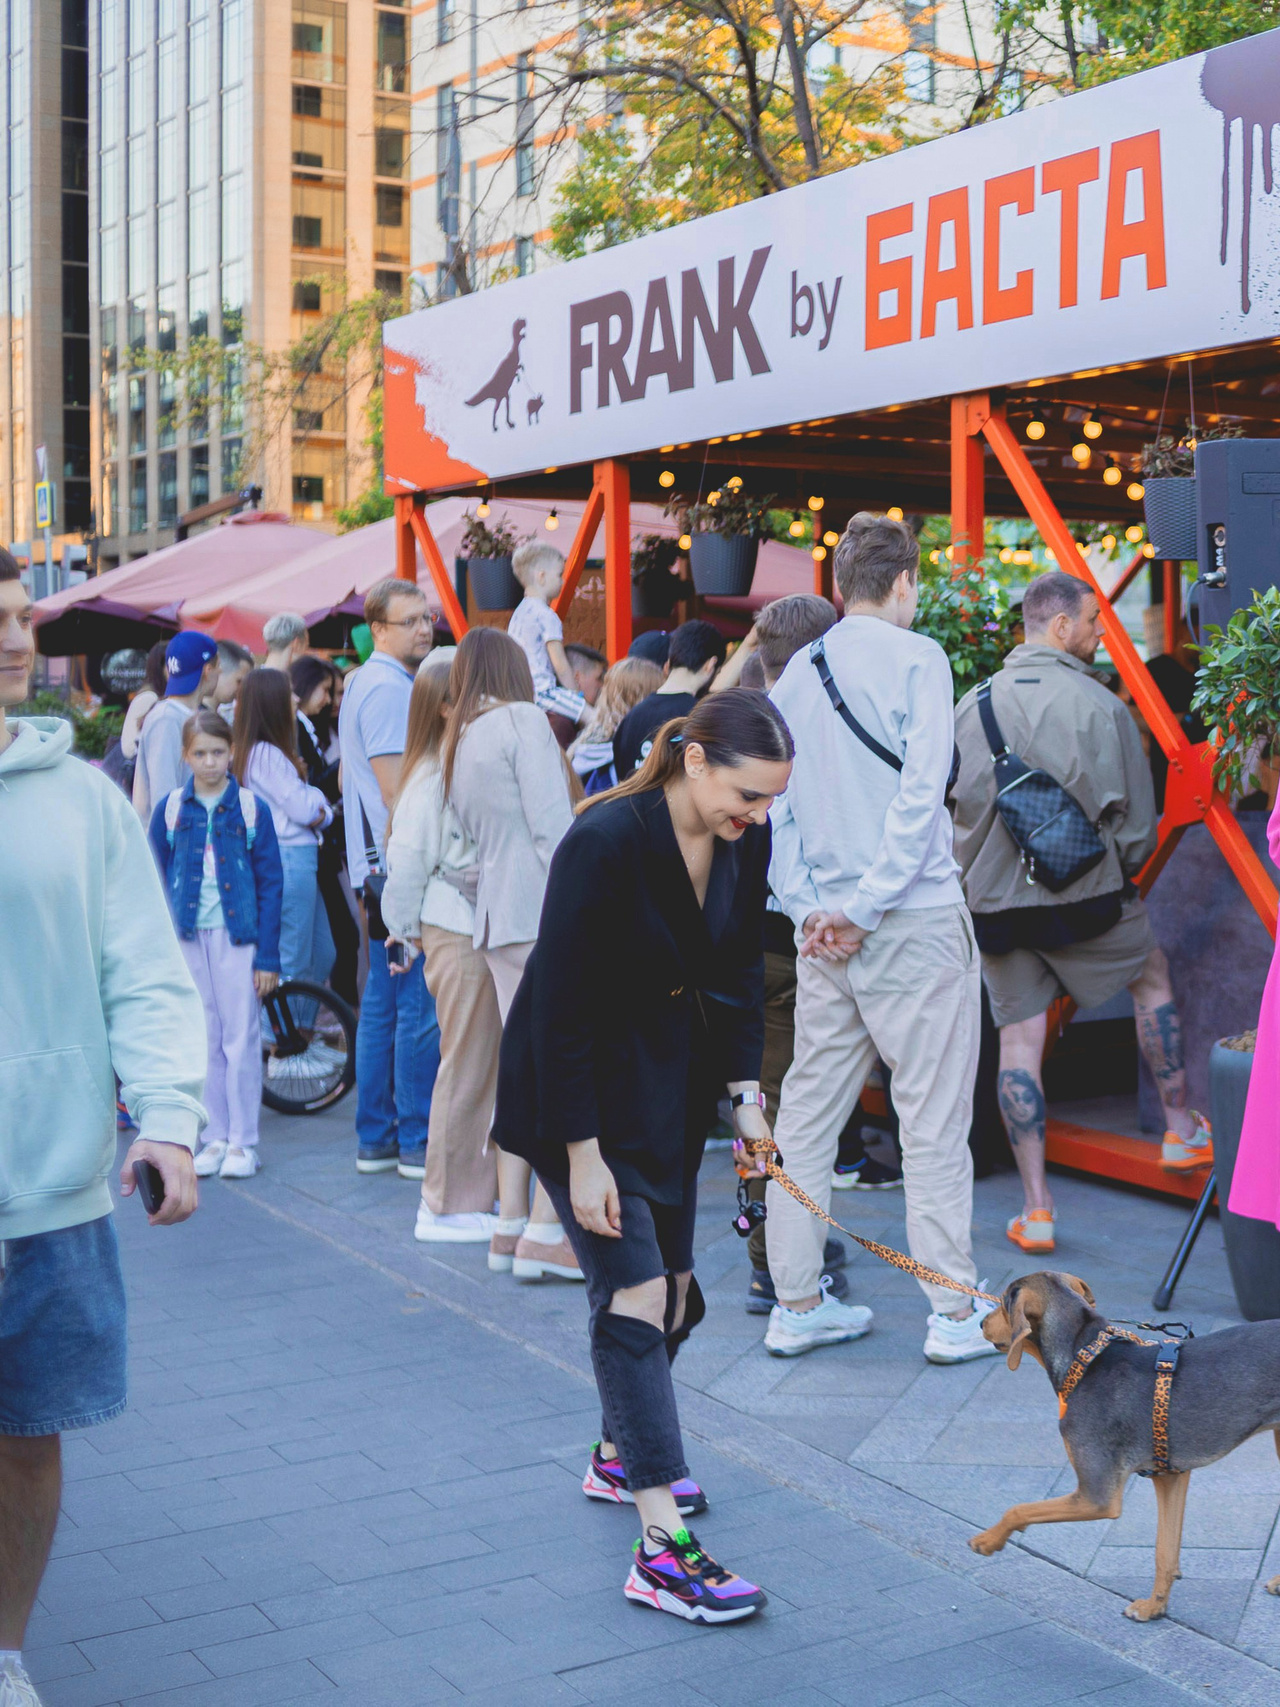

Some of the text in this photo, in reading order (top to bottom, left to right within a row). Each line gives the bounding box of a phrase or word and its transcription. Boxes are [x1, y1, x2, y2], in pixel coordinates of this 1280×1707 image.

[569, 128, 1168, 415] FRANK by БАСТА
